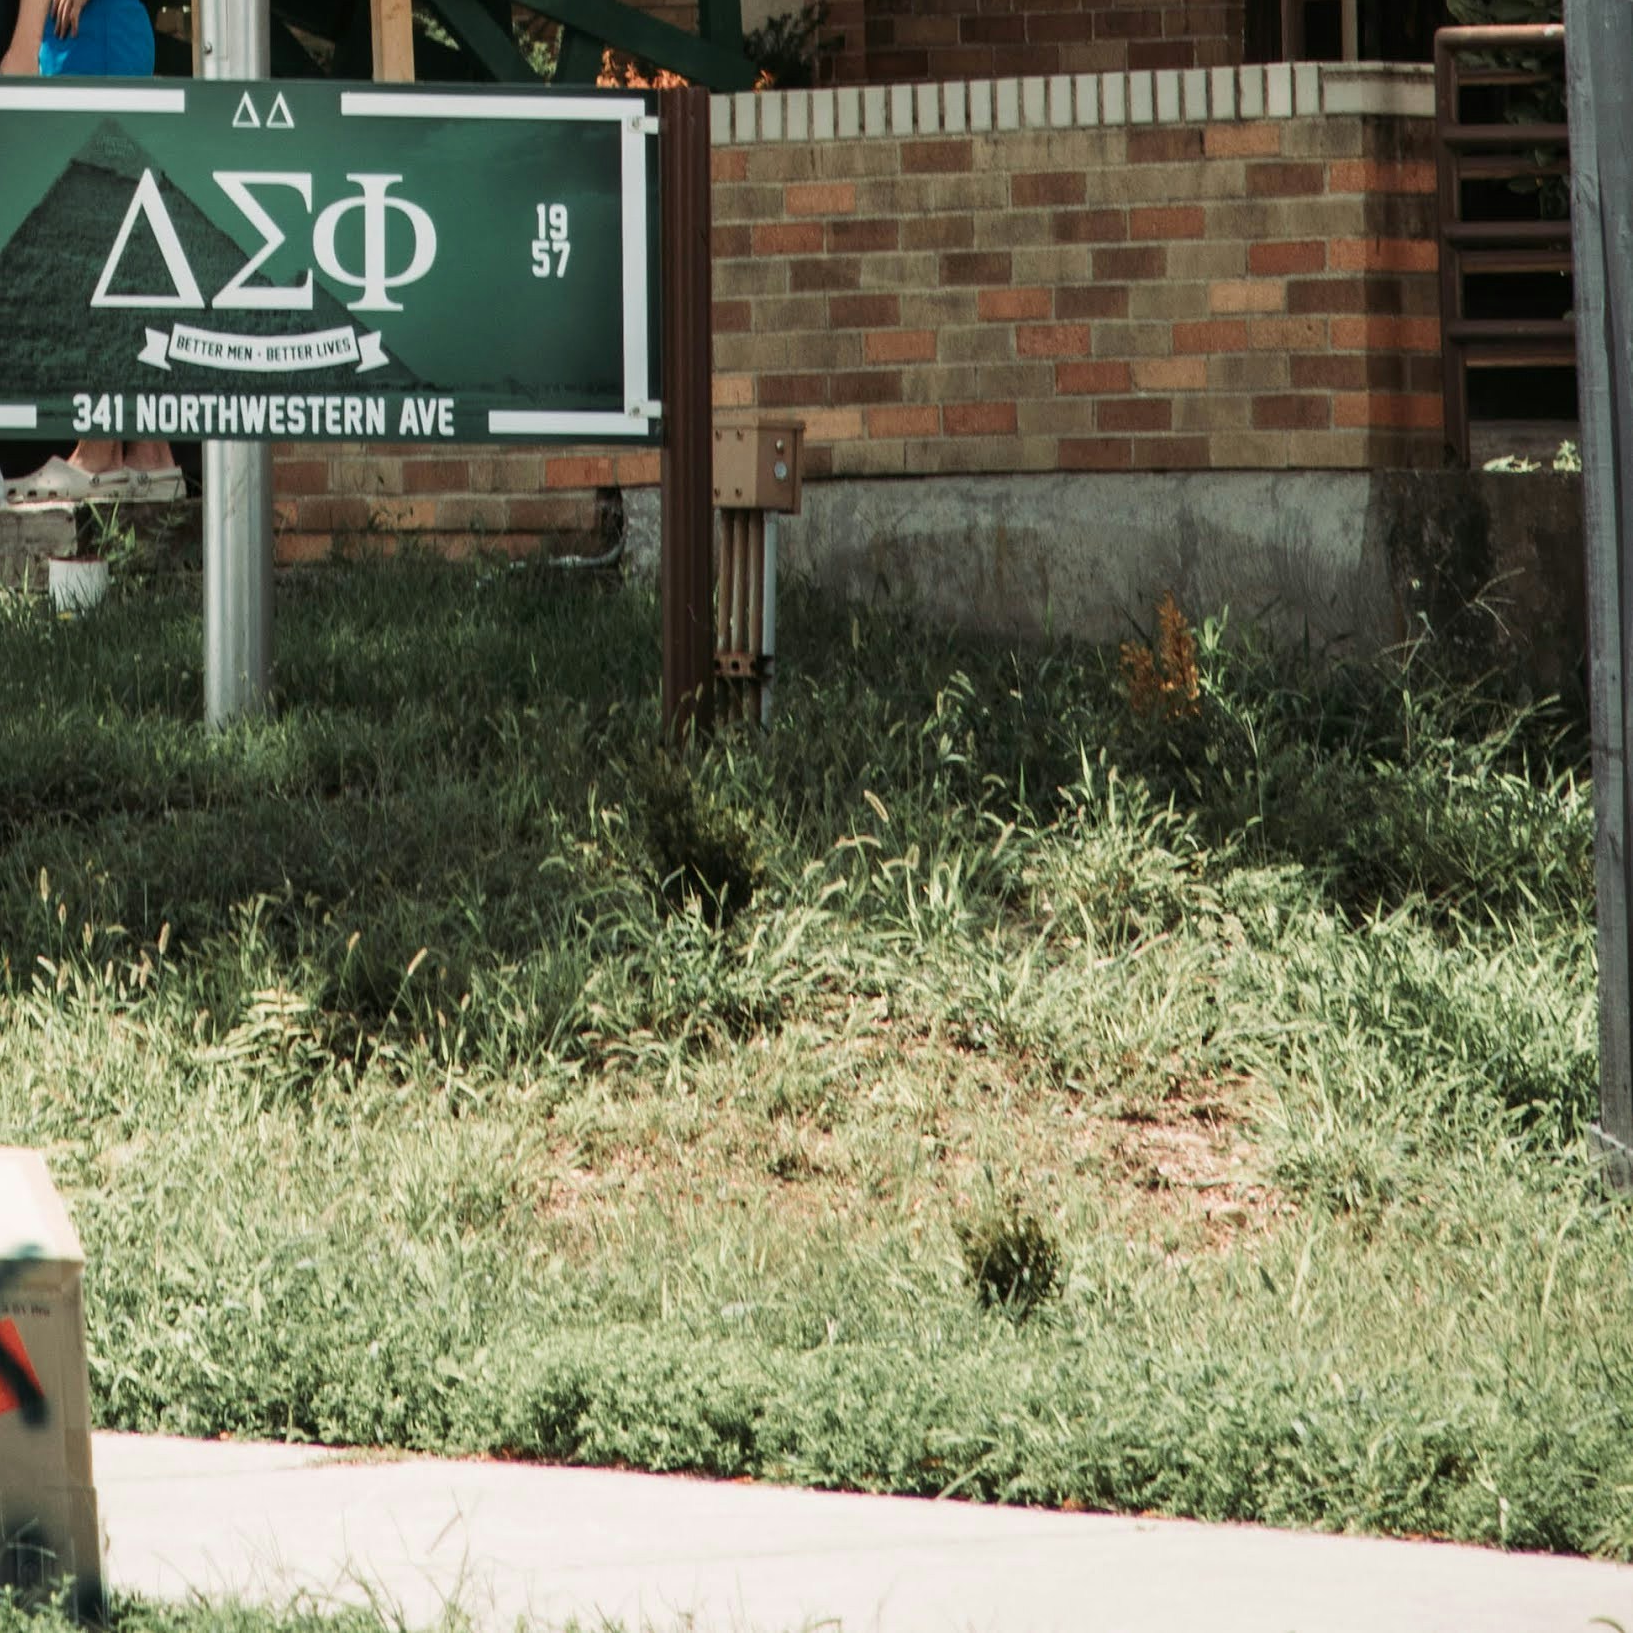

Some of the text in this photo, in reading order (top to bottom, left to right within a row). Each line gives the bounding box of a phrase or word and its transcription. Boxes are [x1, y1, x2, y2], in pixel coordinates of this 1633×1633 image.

[90, 167, 438, 312] ΔΣΦ
[536, 202, 569, 240] 19
[531, 239, 571, 278] 57
[176, 335, 352, 362] BETTER MEN BETTER LIVES
[72, 393, 455, 436] 341 NORTHWESTERN AVE
